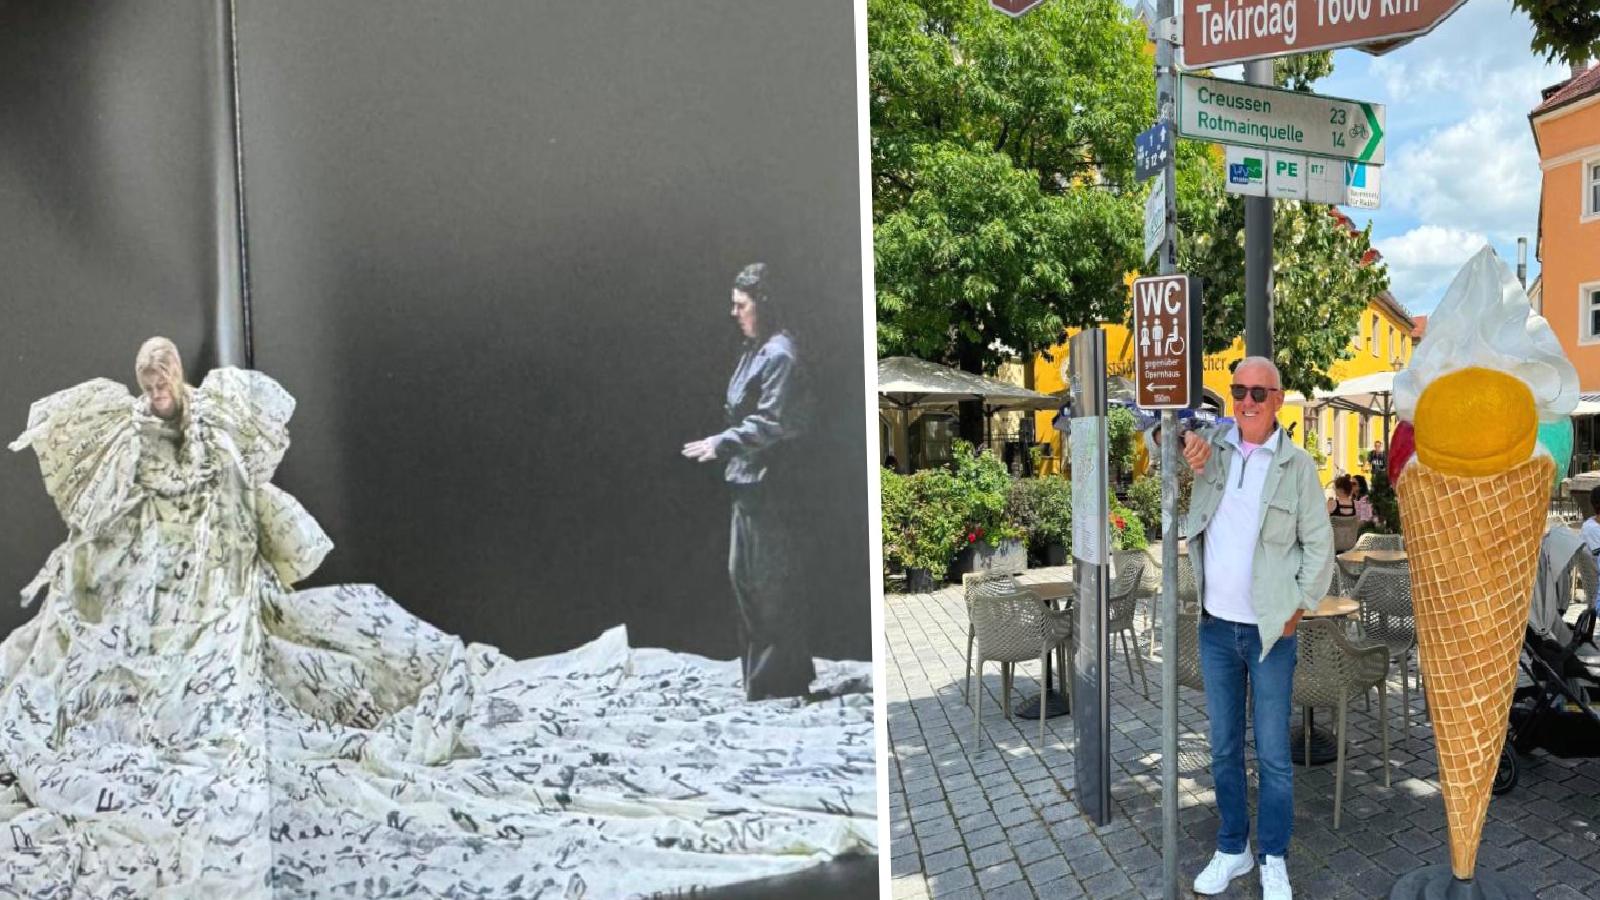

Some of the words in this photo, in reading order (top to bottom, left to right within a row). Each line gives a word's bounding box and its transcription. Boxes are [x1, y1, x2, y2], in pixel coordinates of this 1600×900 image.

[1196, 0, 1297, 46] Tekirdag
[1198, 86, 1271, 113] Creussen
[1330, 107, 1346, 125] 23
[1198, 111, 1304, 143] Rotmainquelle
[1332, 131, 1346, 147] 14
[1276, 161, 1297, 177] PE
[1140, 280, 1181, 317] WC
